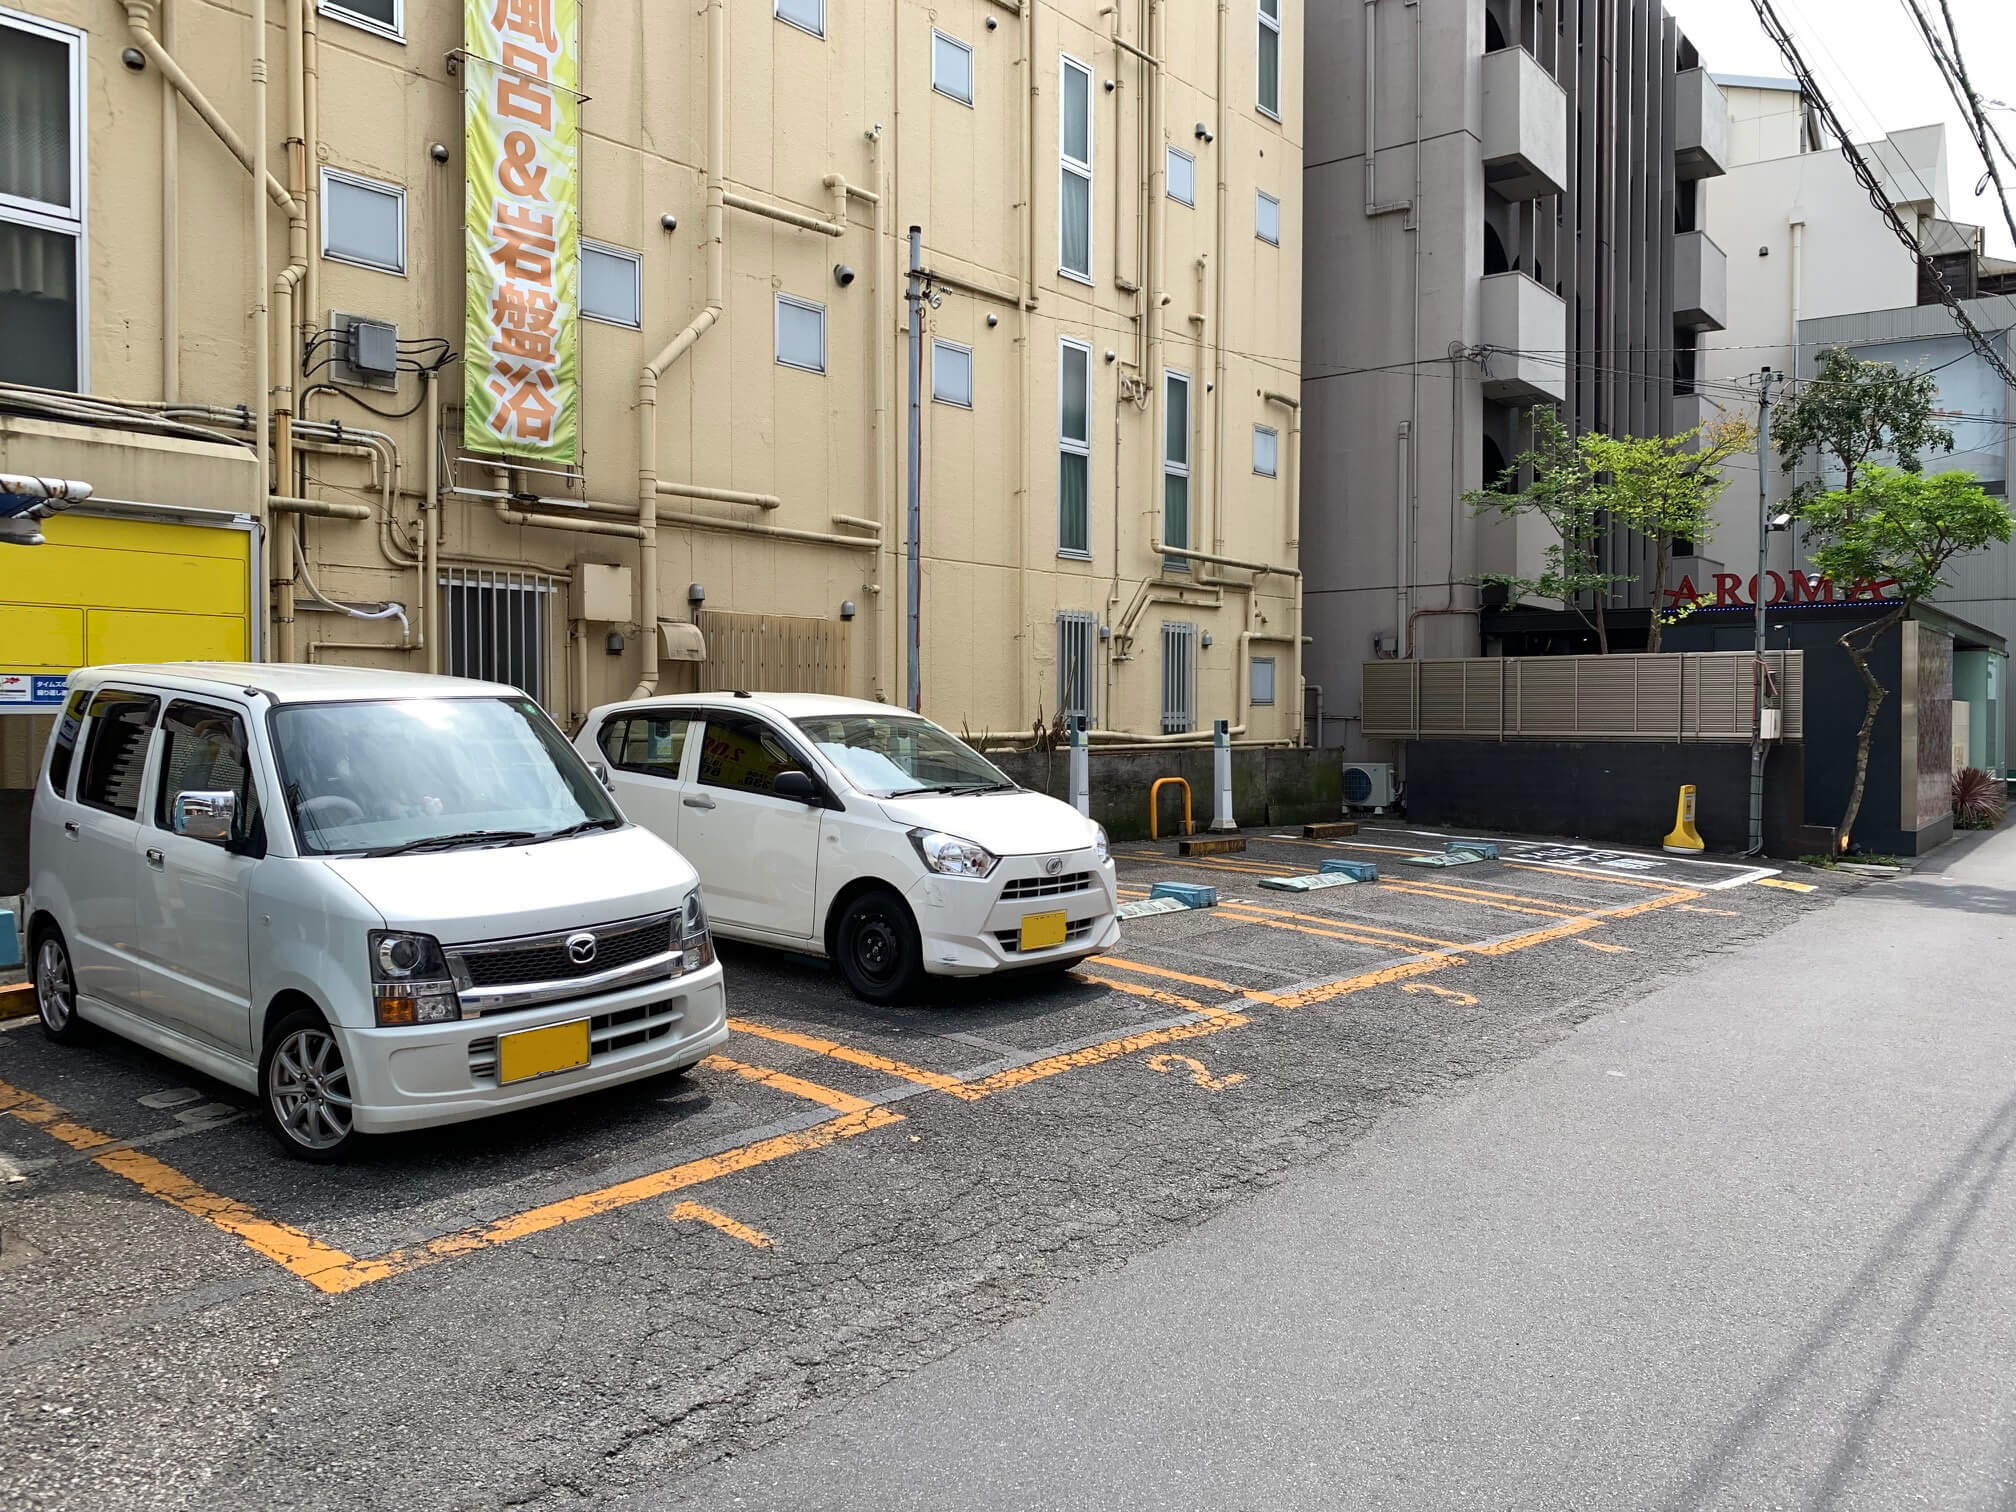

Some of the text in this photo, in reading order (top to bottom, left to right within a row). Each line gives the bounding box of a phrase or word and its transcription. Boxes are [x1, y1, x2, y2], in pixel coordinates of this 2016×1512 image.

[1664, 569, 1897, 609] AROMA
[1145, 1053, 1248, 1092] 2
[669, 1201, 775, 1248] 1
